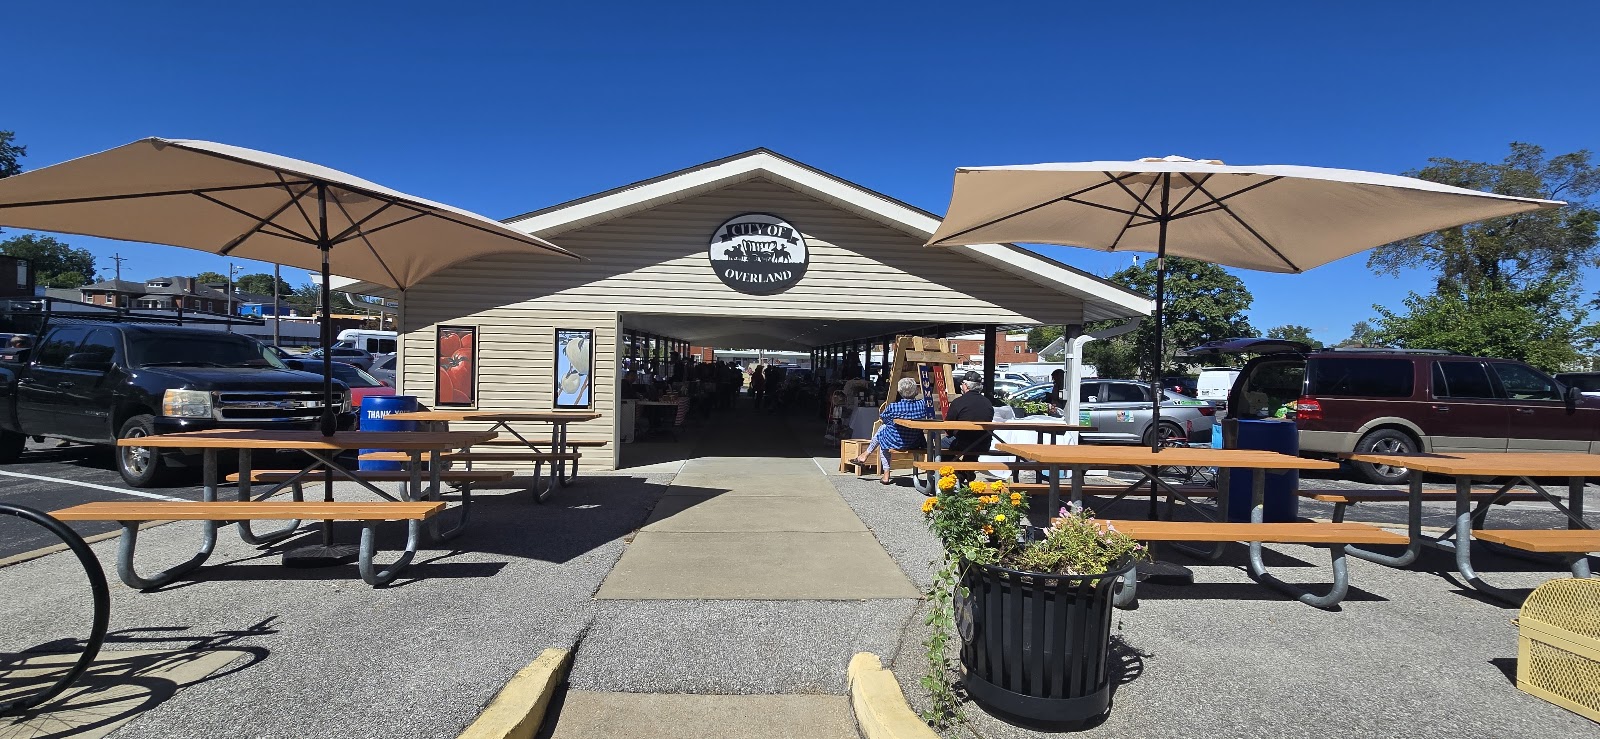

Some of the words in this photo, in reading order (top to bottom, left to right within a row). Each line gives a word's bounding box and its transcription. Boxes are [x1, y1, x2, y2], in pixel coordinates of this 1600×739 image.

[731, 224, 765, 236] CITY
[767, 224, 787, 236] OF
[724, 268, 792, 283] OVERLAND
